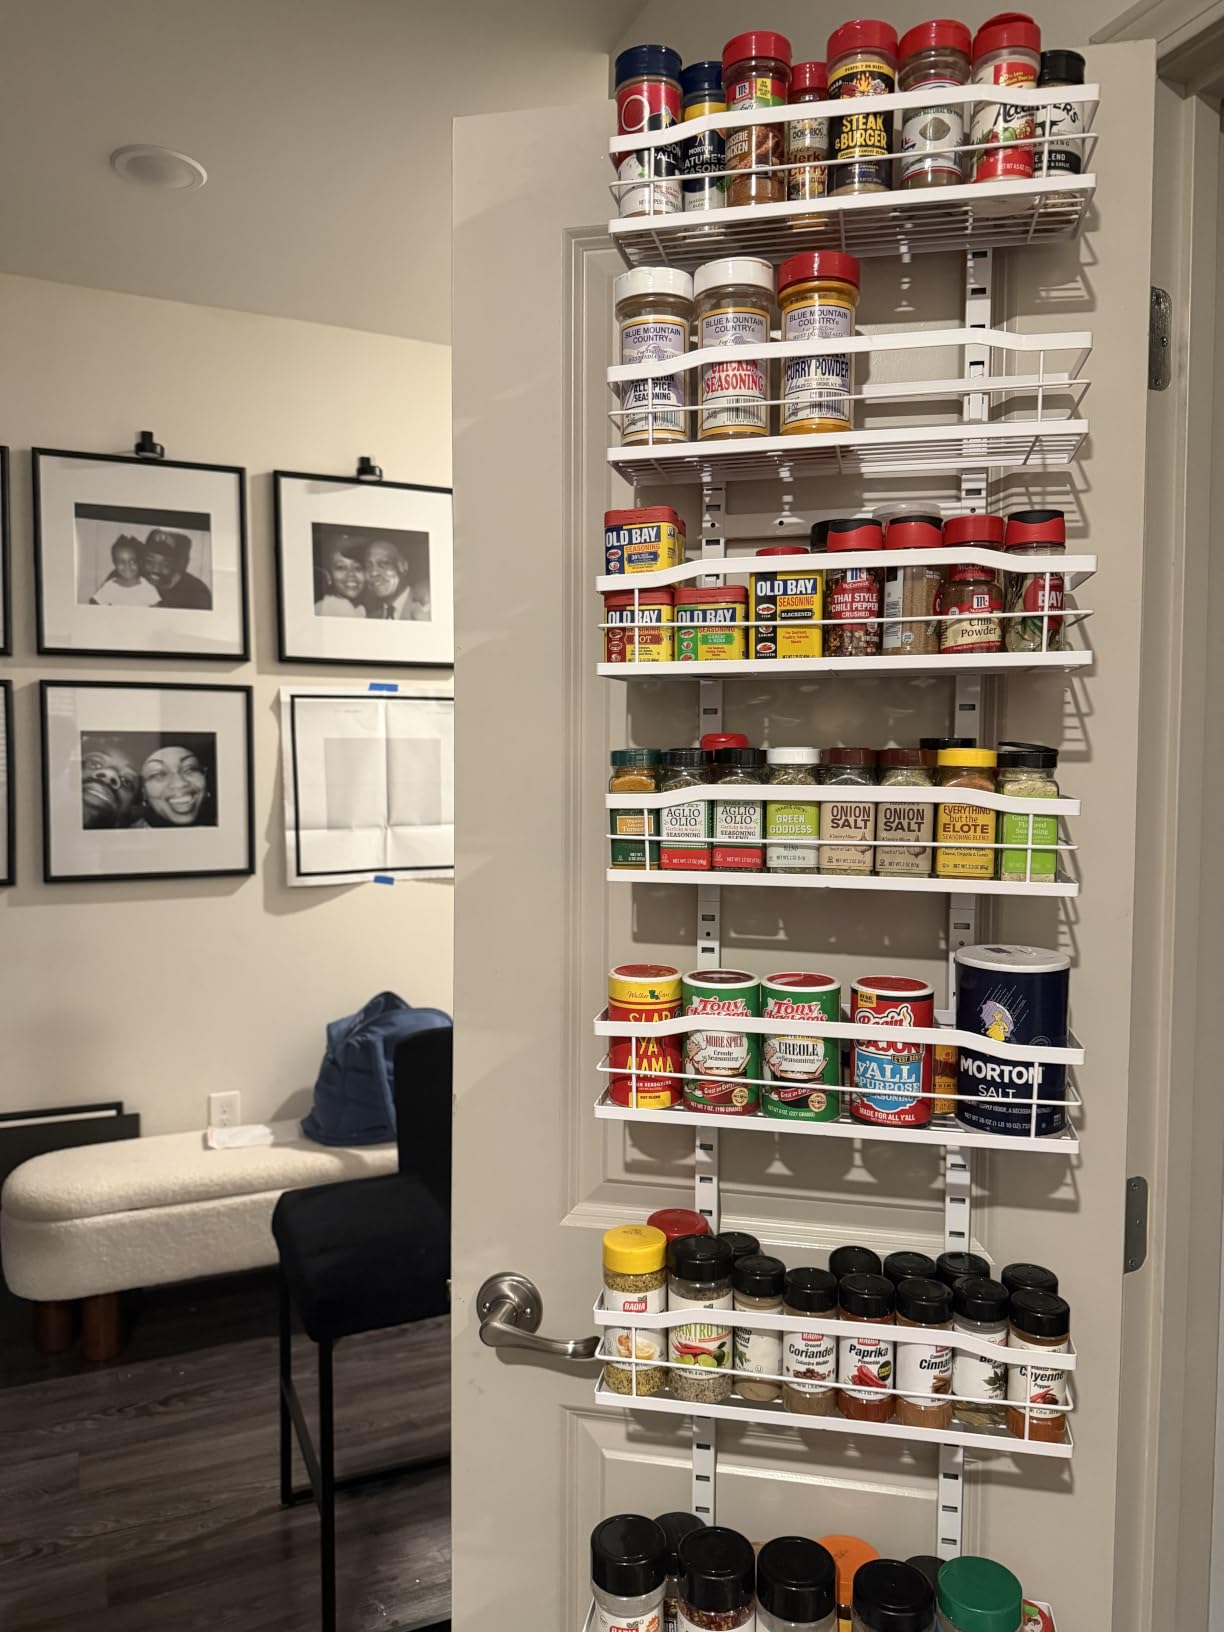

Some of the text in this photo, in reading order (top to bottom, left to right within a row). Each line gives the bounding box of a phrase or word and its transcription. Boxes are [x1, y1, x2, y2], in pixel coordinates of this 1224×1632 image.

[842, 113, 885, 133] STEAK
[681, 154, 727, 169] ATURE'S
[705, 318, 723, 329] BLUE
[789, 312, 809, 323] BLUE
[624, 327, 681, 339] BLUE MOUNTAIN
[714, 324, 752, 334] COUNTRY
[632, 334, 669, 344] COUNTRY
[711, 359, 758, 375] CHICKEN
[786, 358, 848, 382] CURRY POWDER
[705, 373, 764, 395] SEASONING
[606, 527, 657, 547] OLD BAY
[624, 543, 661, 553] SEASONING
[756, 579, 815, 597] OLD BAY
[778, 596, 814, 608] SEASONING
[834, 593, 877, 604] THAI STYLE
[831, 602, 879, 613] CHILI PEPPER
[607, 609, 658, 624] OLD BAY
[678, 609, 733, 623] OLD BAY
[961, 626, 997, 638] Powder
[667, 808, 701, 818] AGLIO
[721, 806, 756, 817] AGLIO
[831, 805, 870, 819] ONION
[884, 807, 924, 822] ONION
[943, 805, 991, 816] EVERYTHING
[670, 817, 697, 827] OLIO
[725, 815, 752, 826] OLIO
[776, 814, 805, 824] GREEN
[831, 818, 870, 830] SALT
[949, 815, 979, 824] but the
[769, 825, 812, 835] GODDESS
[883, 821, 924, 833] SALT
[942, 823, 989, 834] ELOTE
[666, 831, 701, 839] SEASONING
[720, 829, 756, 838] SEASONING
[699, 997, 744, 1012] Tony
[774, 999, 820, 1016] Tony
[638, 1037, 658, 1055] YA
[705, 1035, 744, 1048] MORE SPICE
[713, 1049, 733, 1057] Creole
[778, 1042, 819, 1057] CREOLE
[708, 1055, 740, 1063] Seasoning
[781, 1055, 816, 1064] Seasoning
[857, 1060, 916, 1084] y'ALL
[960, 1055, 1043, 1084] MORTON
[858, 1077, 921, 1093] PURPOSE
[978, 1085, 1017, 1099] SALT
[859, 1107, 916, 1121] MADE FOR ALL Y'ALL
[624, 1302, 647, 1311] BADIA
[788, 1343, 835, 1359] Coriander
[849, 1344, 889, 1360] Paprika
[919, 1356, 952, 1370] Cinna
[1019, 1366, 1065, 1383] Cyenne
